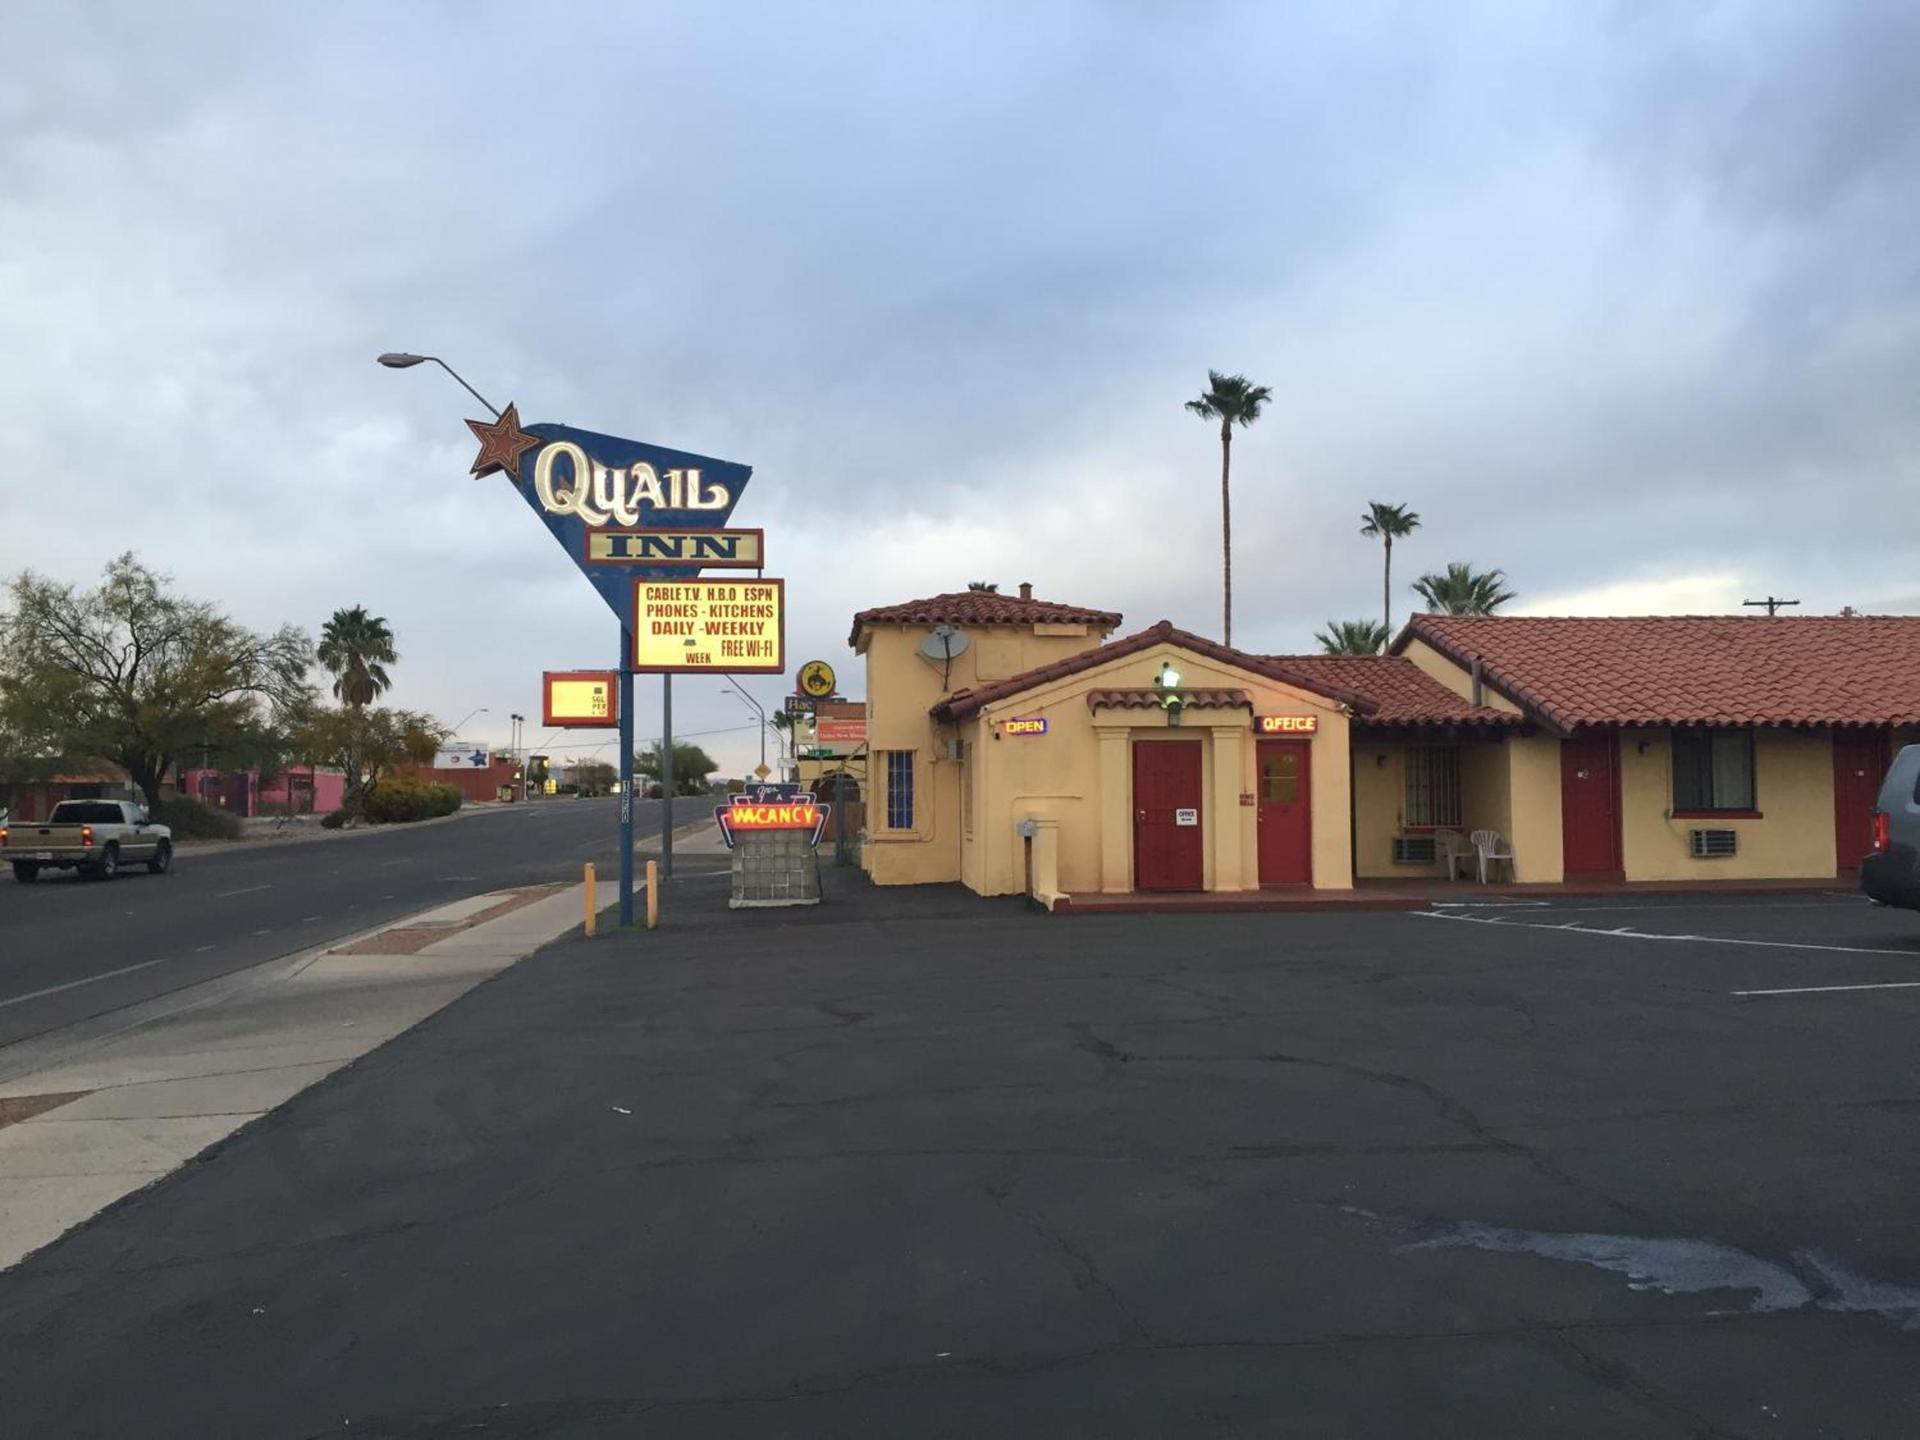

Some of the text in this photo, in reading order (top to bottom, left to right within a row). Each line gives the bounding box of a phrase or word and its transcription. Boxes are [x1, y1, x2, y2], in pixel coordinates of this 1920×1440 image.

[606, 535, 742, 558] INN
[646, 587, 681, 601] CABLE
[744, 587, 773, 602] ESPN
[646, 604, 698, 617] PHONES
[709, 604, 774, 618] KITCHENS
[652, 621, 694, 635] DAILY
[721, 640, 773, 657] FREE WI-FI
[686, 652, 711, 664] WEEK
[1006, 721, 1044, 733] OPEN
[1263, 717, 1316, 731] OFFICE
[732, 806, 814, 824] VACANCY
